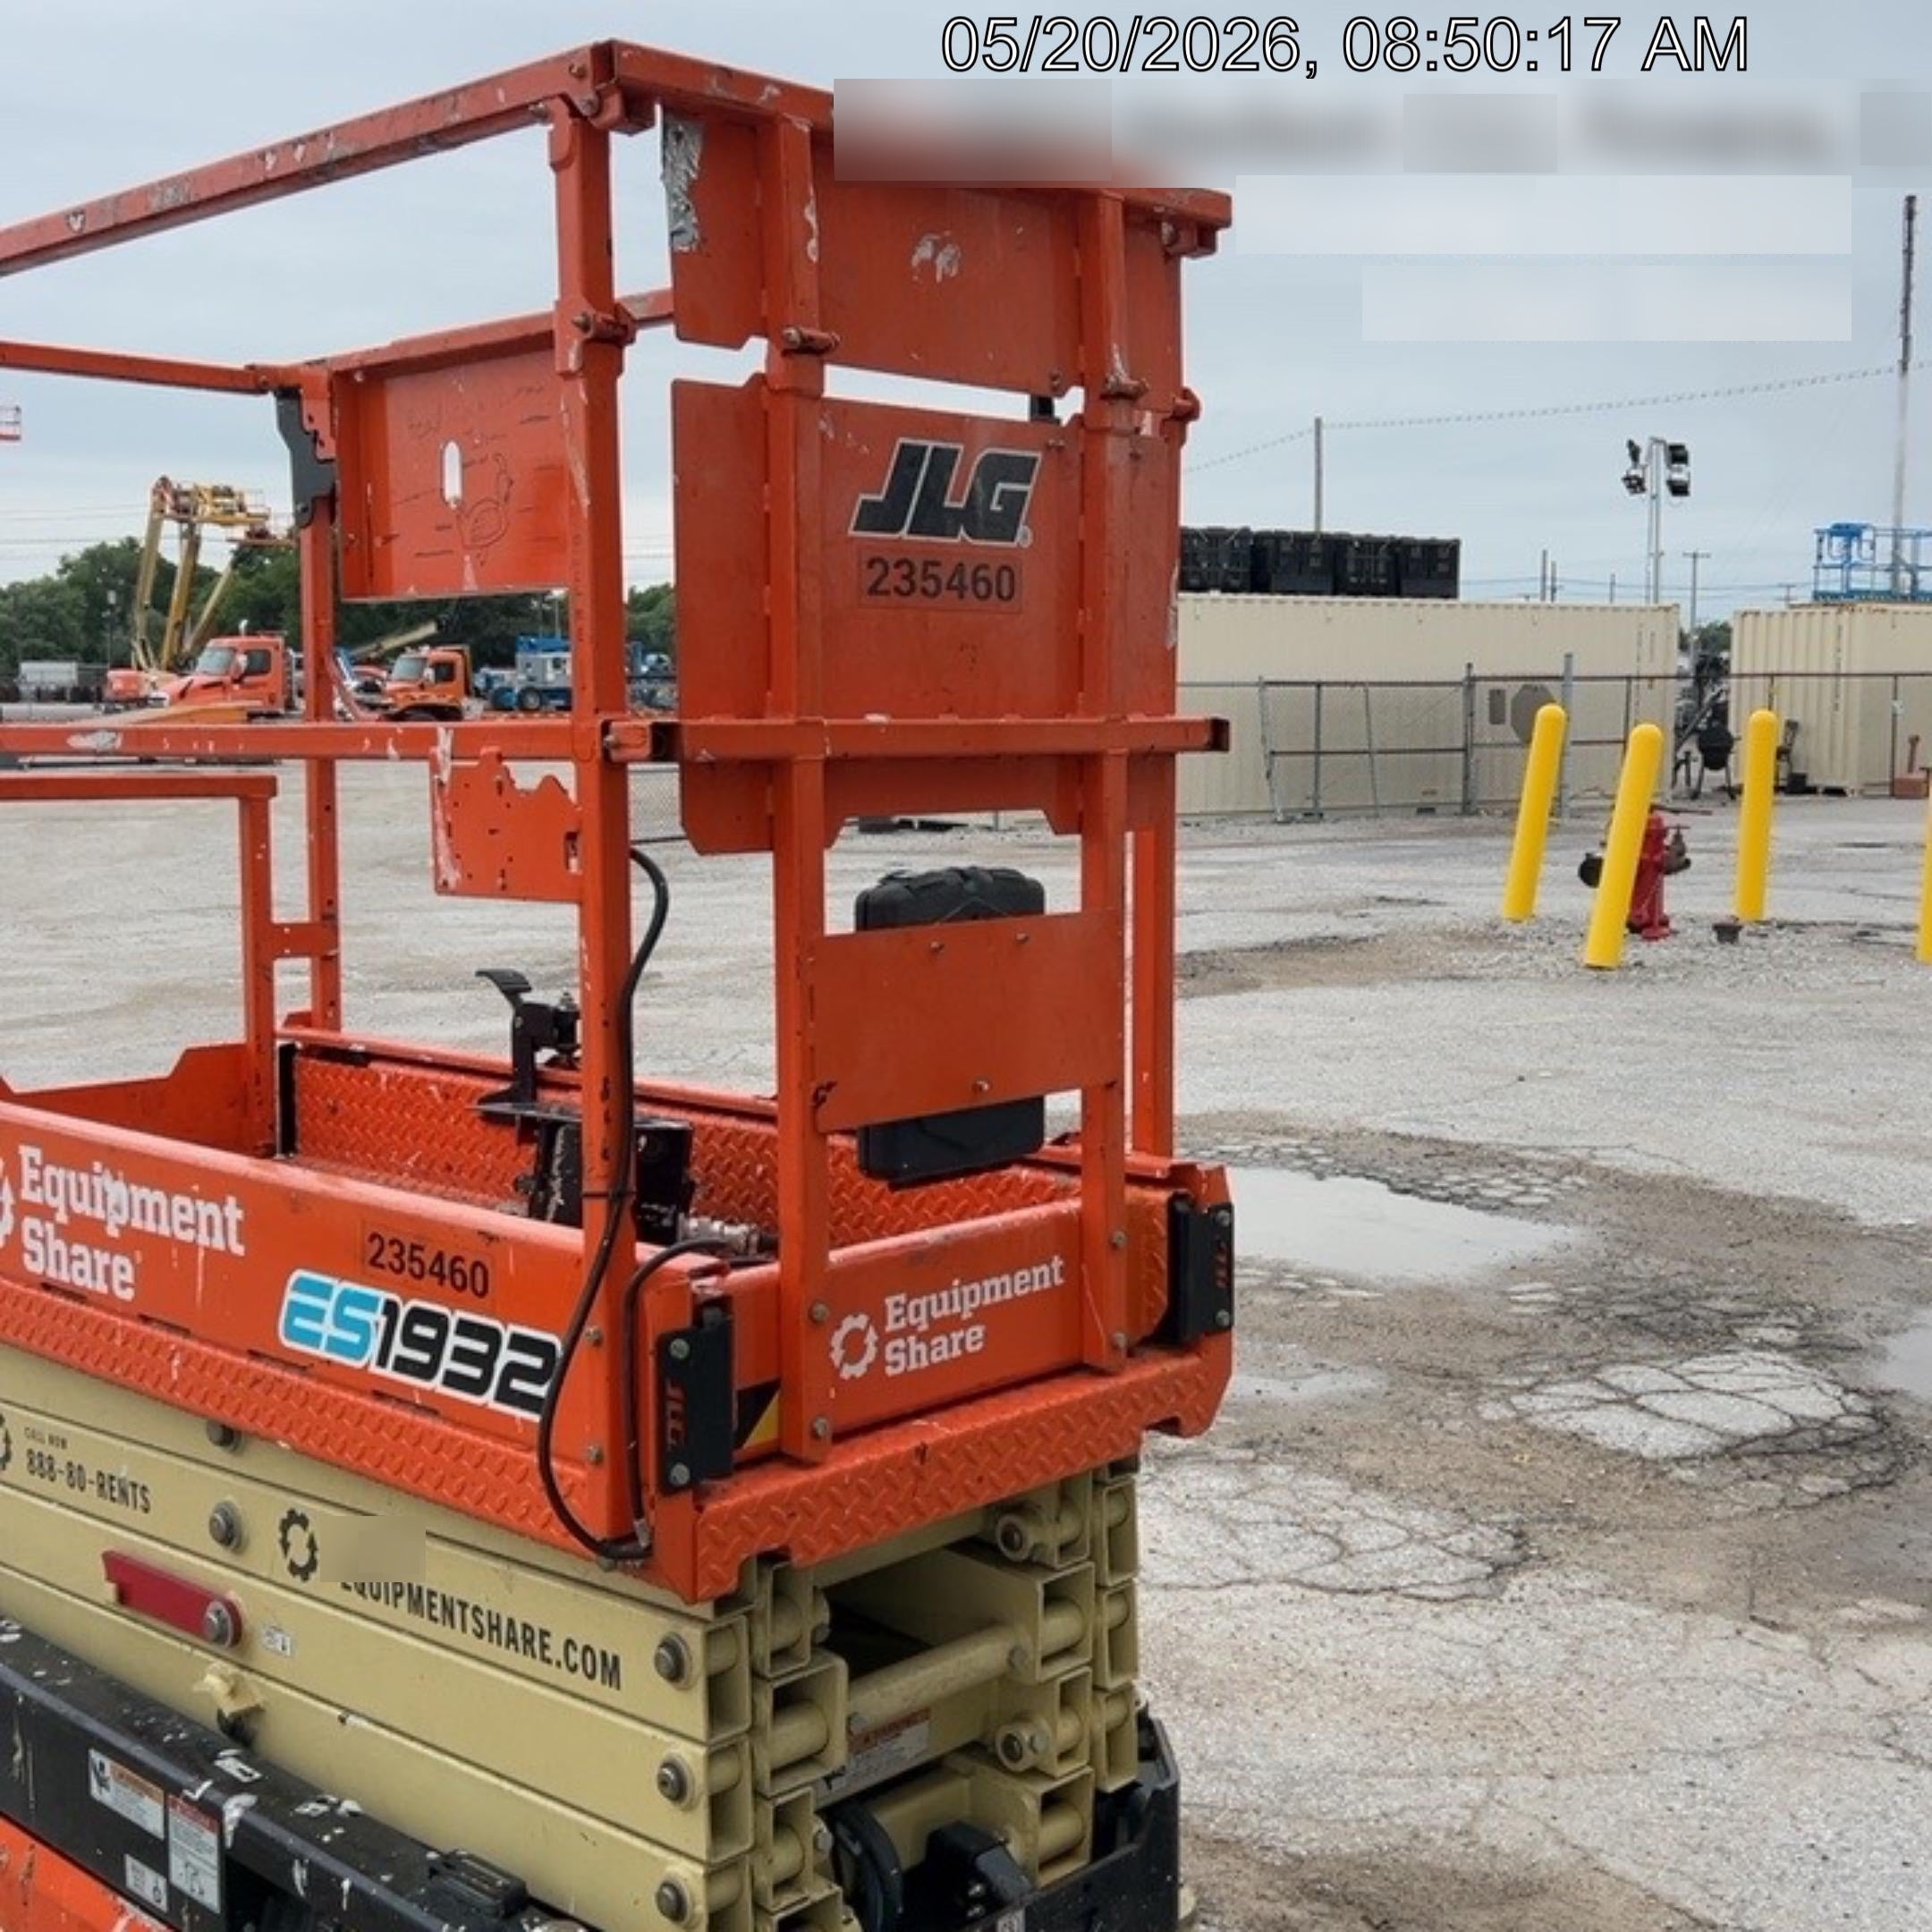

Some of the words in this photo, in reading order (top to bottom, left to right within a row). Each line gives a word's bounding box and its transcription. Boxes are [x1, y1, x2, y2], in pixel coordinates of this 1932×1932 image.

[849, 436, 1041, 547] JLG
[866, 556, 1016, 602] 235460
[18, 1144, 245, 1256] Equipment
[21, 1216, 135, 1301] Share
[368, 1233, 489, 1298] 235460
[884, 1257, 1064, 1332] Equipment
[279, 1269, 565, 1422] ES1932
[884, 1326, 985, 1377] Share
[26, 1448, 151, 1514] 888-80-RENTS
[341, 1582, 622, 1690] QUIPMENTSHARE.COM
